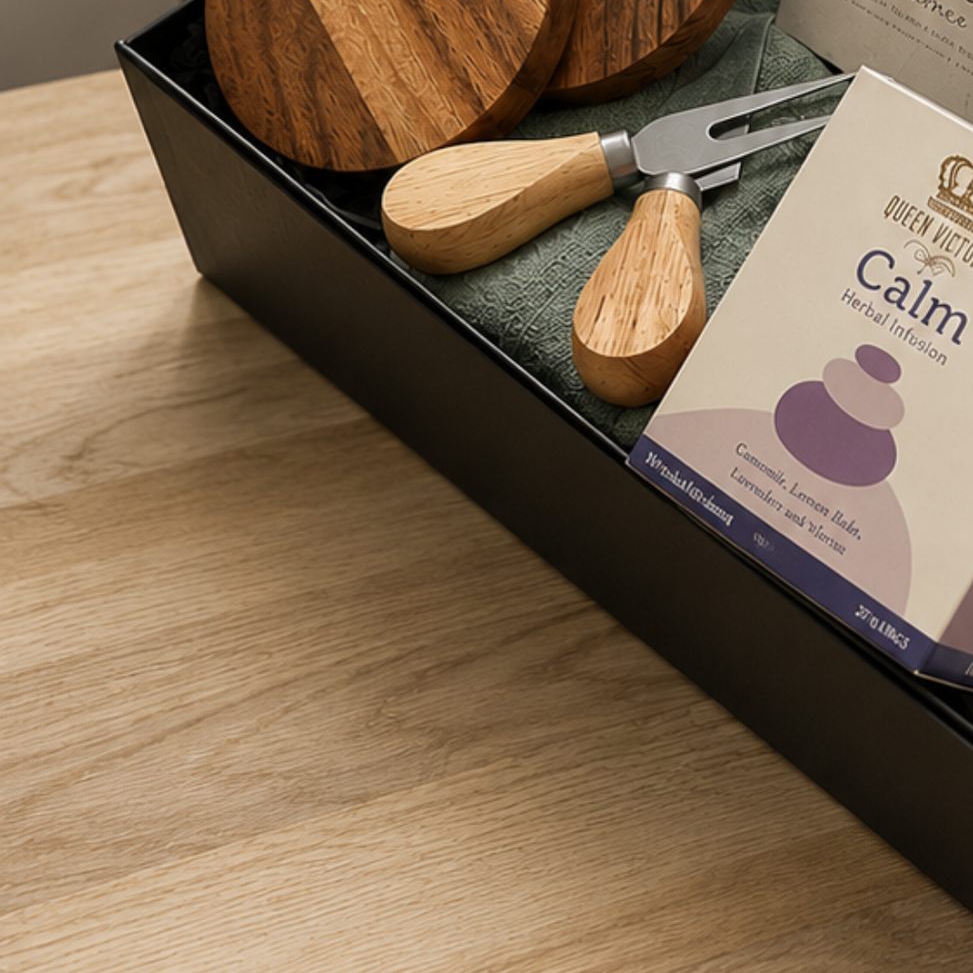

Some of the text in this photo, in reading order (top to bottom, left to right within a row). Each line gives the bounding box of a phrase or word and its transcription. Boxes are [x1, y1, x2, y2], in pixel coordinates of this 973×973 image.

[883, 194, 934, 237] QUEEN
[841, 288, 949, 368] Herbal Infusion
[856, 249, 970, 346] Calm
